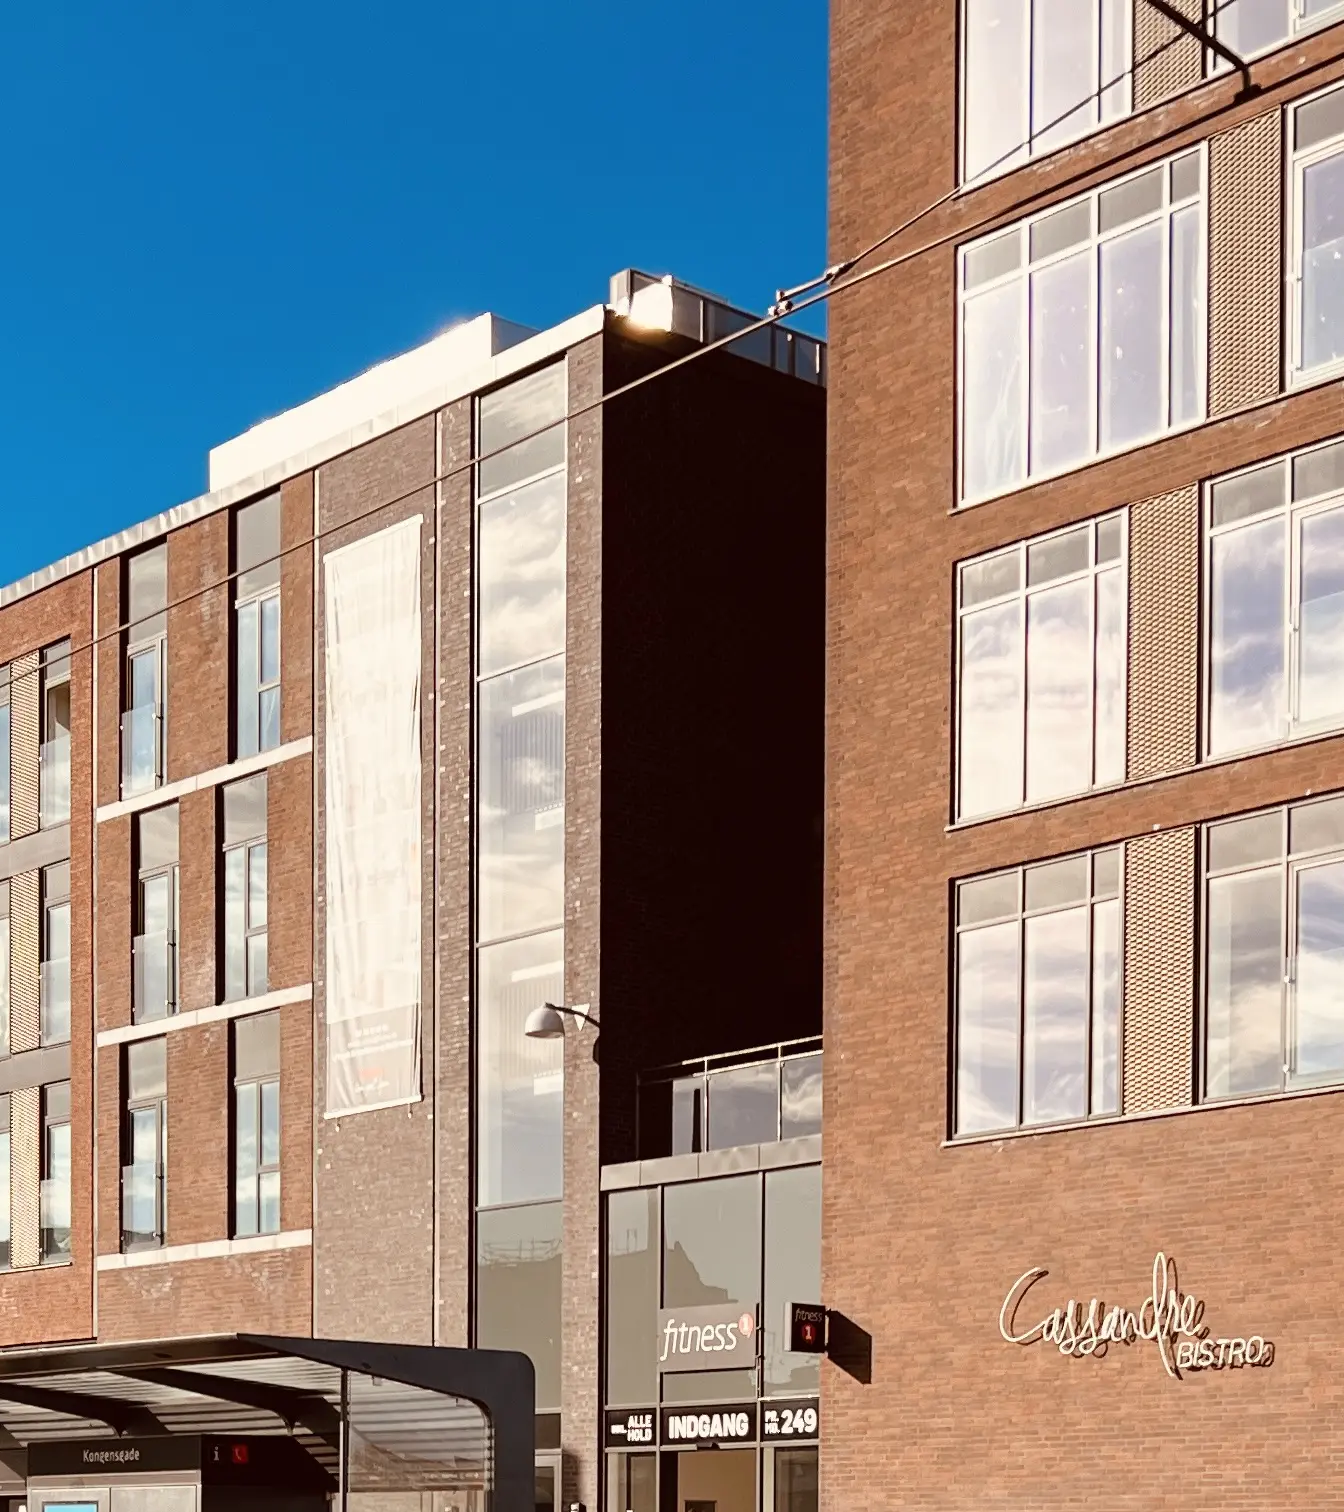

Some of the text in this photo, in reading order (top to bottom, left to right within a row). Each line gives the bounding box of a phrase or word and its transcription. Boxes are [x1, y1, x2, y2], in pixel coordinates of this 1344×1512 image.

[795, 1308, 823, 1322] fitness
[1000, 1251, 1202, 1377] Cassandre
[660, 1318, 737, 1361] fitness
[1176, 1336, 1264, 1368] BISTRO
[627, 1415, 652, 1428] ALLE
[668, 1413, 749, 1439] INDGANG
[781, 1408, 817, 1434] 249
[627, 1428, 652, 1441] HOLD
[83, 1448, 140, 1464] Kongensgade
